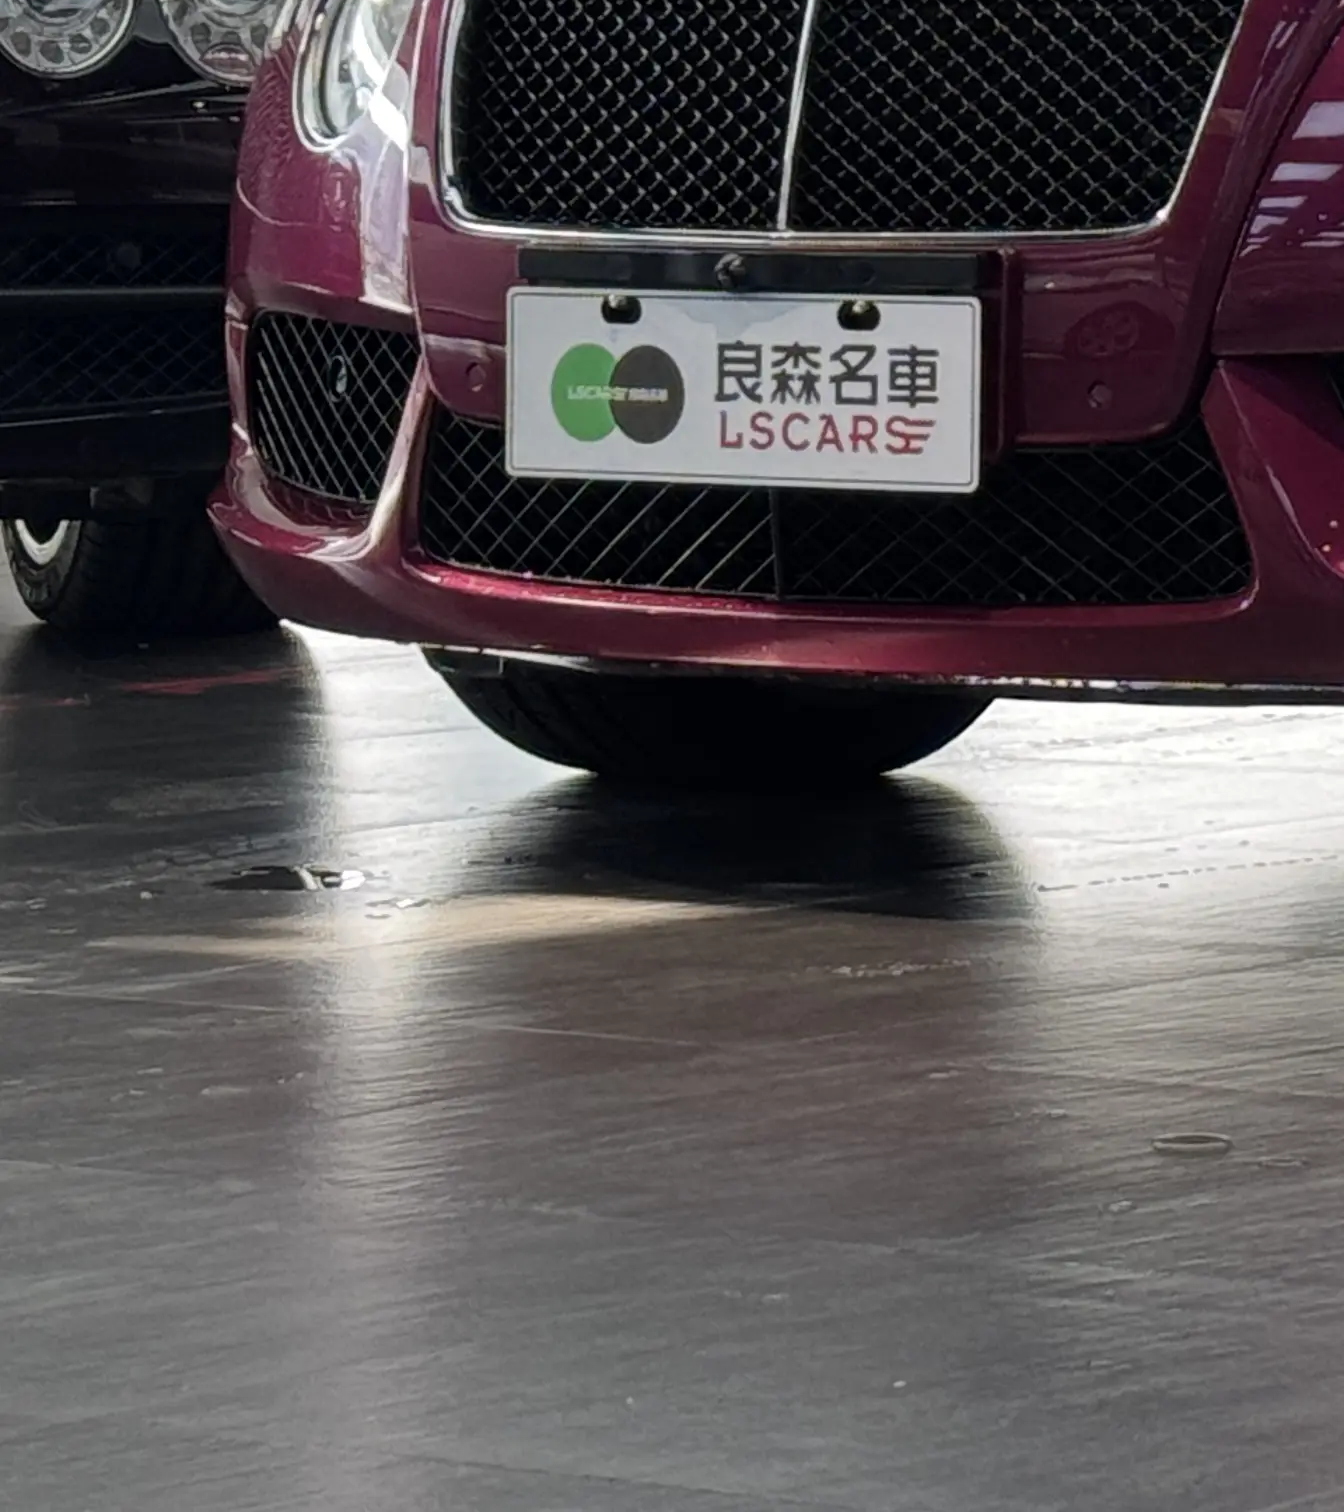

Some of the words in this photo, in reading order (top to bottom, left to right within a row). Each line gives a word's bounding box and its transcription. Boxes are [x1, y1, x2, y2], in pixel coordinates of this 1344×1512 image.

[713, 340, 940, 409] 良森名車
[718, 410, 937, 456] LSCARS
